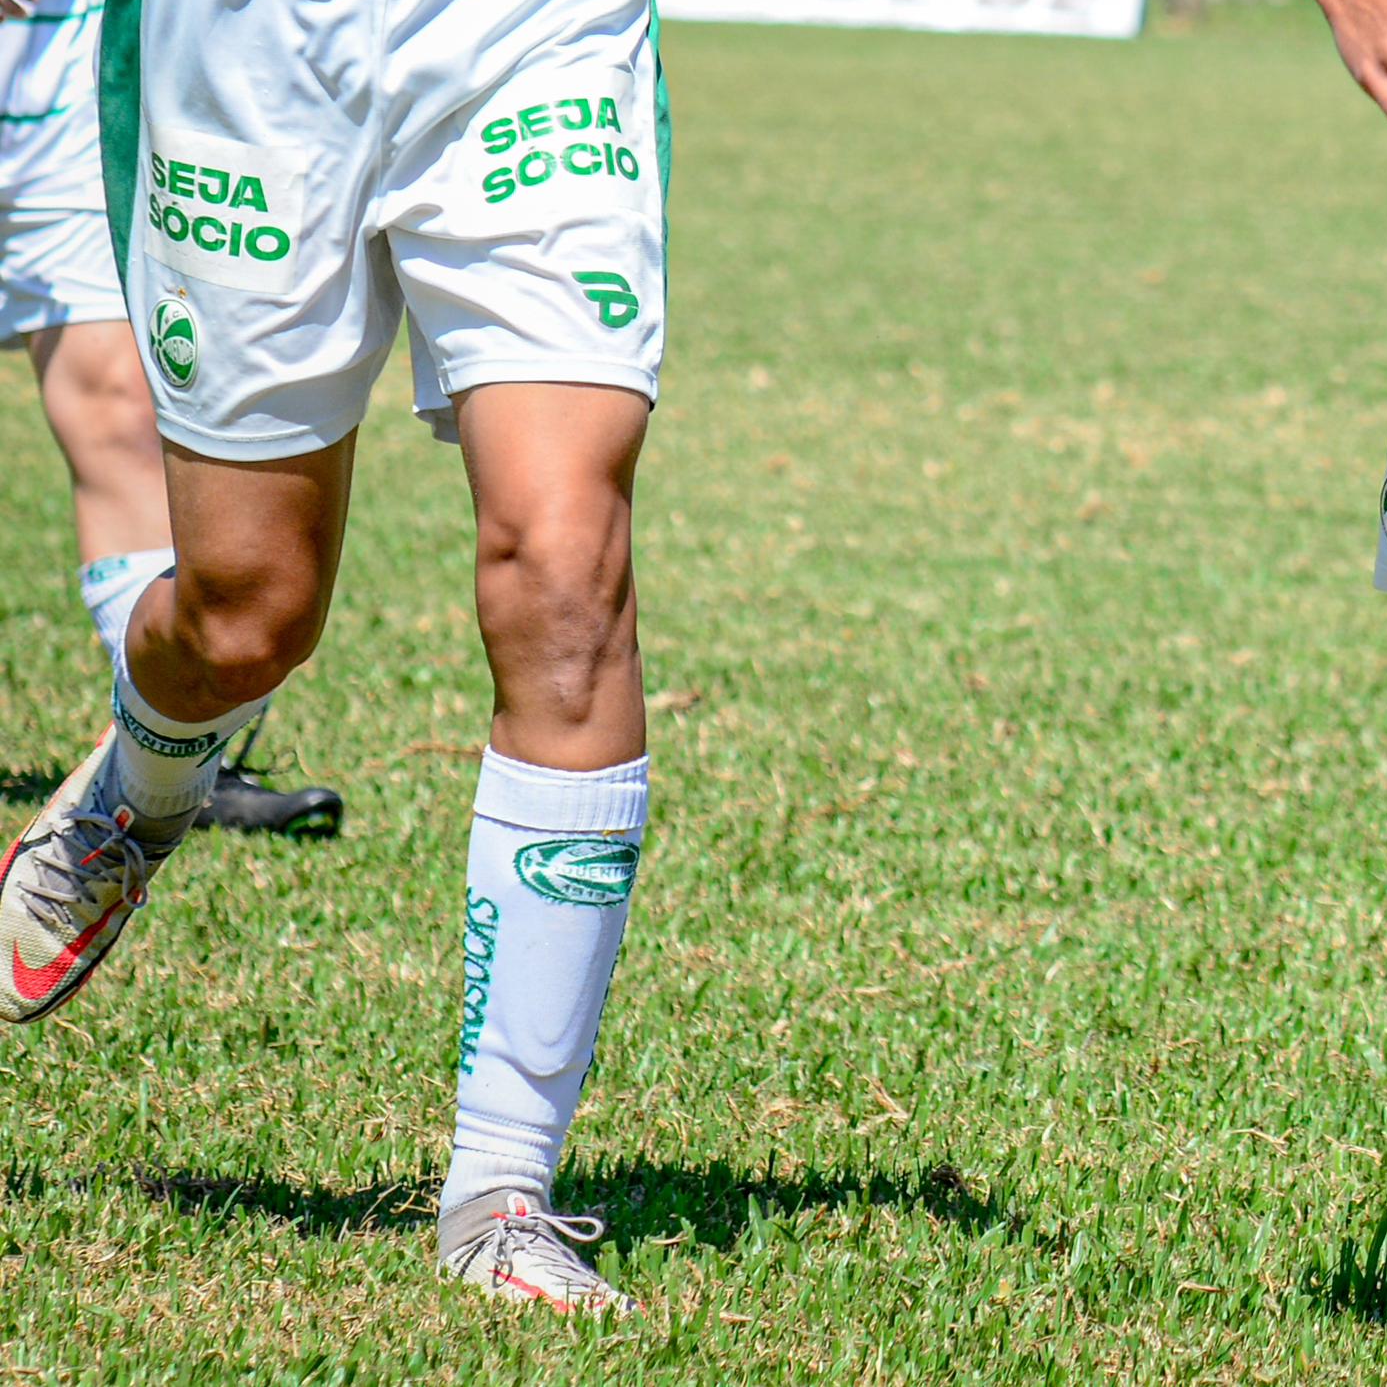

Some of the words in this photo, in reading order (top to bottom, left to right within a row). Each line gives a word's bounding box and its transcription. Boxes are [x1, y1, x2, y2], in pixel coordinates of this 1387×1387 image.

[481, 97, 622, 155] SEJA
[152, 151, 268, 213] SEJA
[149, 193, 291, 262] SÓCIO
